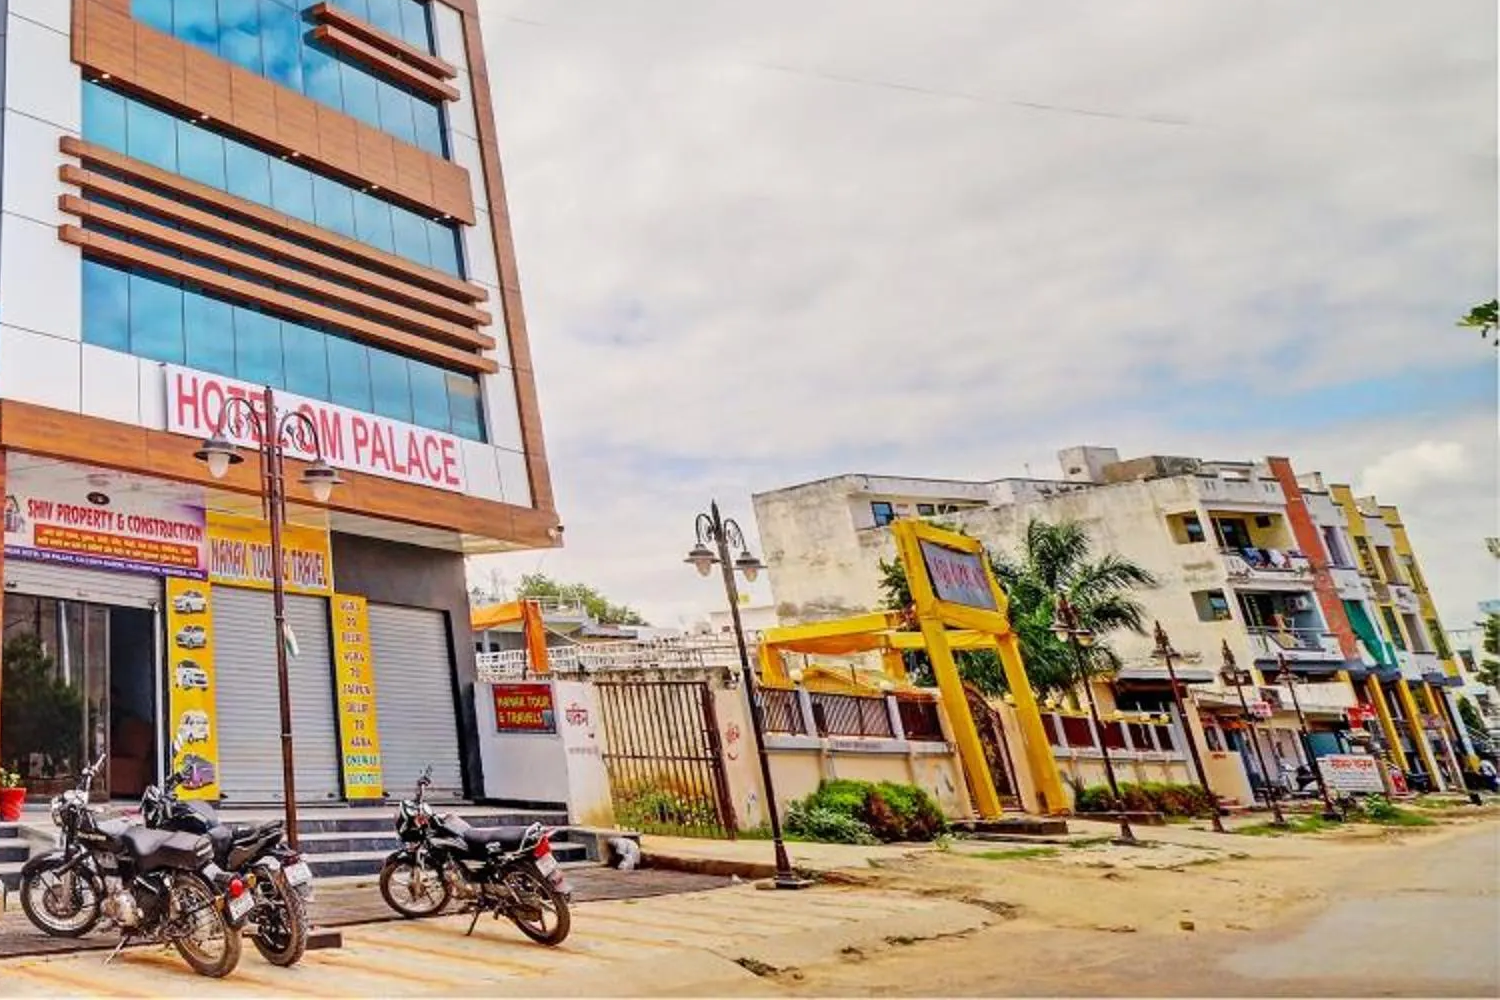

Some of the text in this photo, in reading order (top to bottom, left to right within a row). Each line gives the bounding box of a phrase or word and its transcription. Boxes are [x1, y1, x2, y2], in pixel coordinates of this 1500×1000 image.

[177, 374, 461, 486] HOTE OM PALACE
[27, 498, 53, 518] SHIV
[57, 503, 114, 530] PROPERTY
[117, 514, 125, 531] &
[127, 515, 204, 541] CONSTRUCTION
